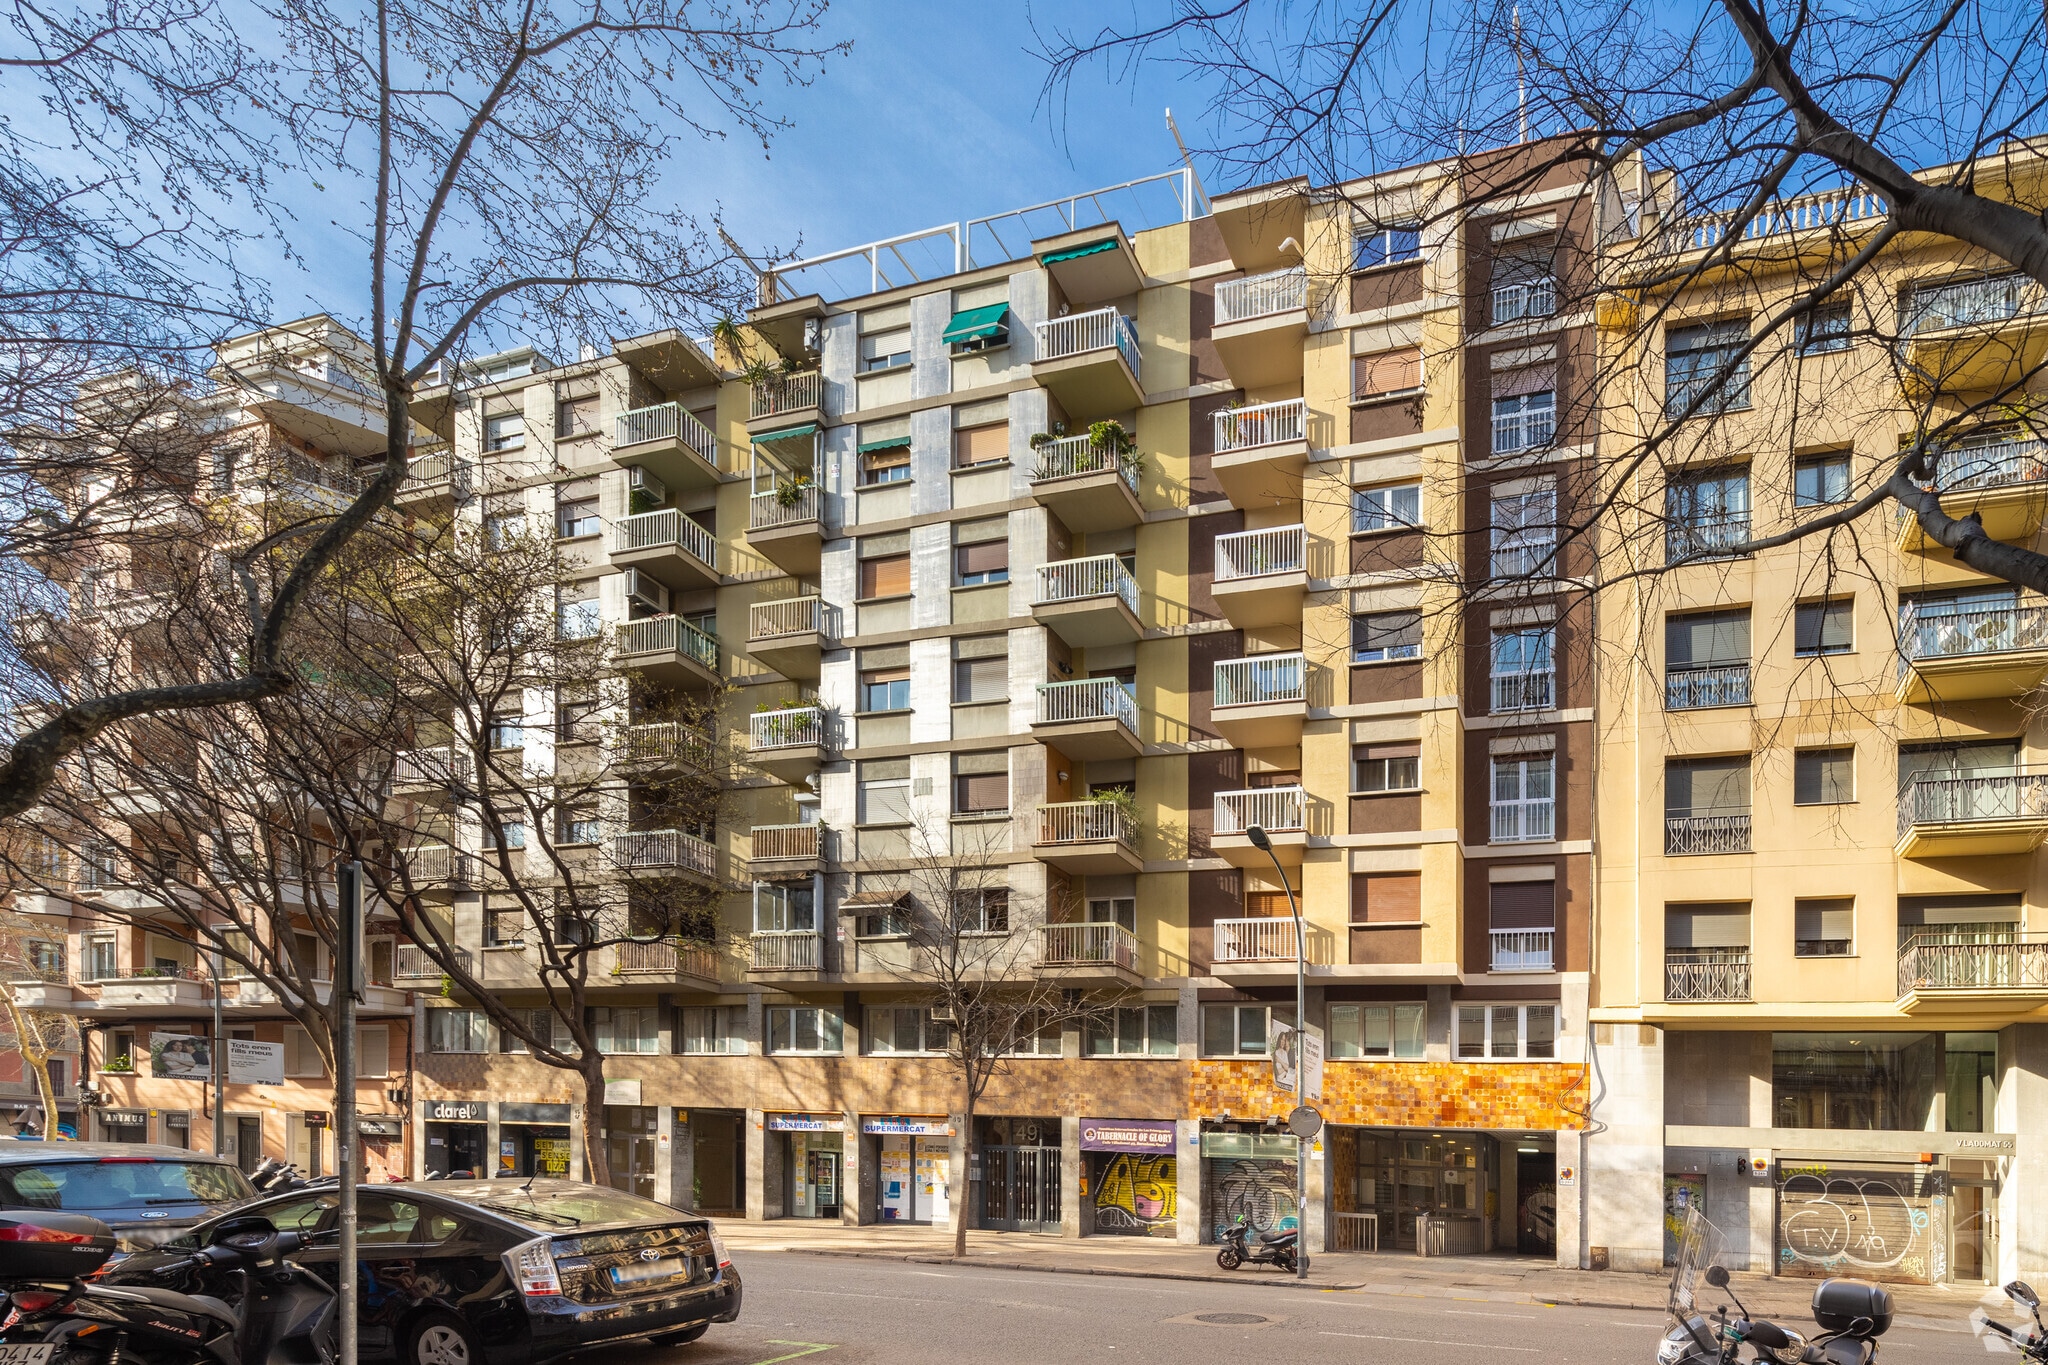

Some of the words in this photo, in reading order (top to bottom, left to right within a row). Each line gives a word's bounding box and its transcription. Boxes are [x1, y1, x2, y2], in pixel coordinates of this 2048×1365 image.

[434, 1103, 471, 1119] clarel
[105, 1113, 144, 1123] ANIMUS
[770, 1121, 822, 1129] SUPERMERCAT
[864, 1125, 926, 1133] SUPERMERCAT
[1015, 1124, 1038, 1141] 49
[1096, 1131, 1137, 1142] TABERNACLE
[1138, 1132, 1148, 1142] OF
[1149, 1133, 1173, 1143] GLORY
[536, 1141, 570, 1149] SETMAN
[541, 1151, 570, 1160] SENSE
[548, 1162, 565, 1170] IVA
[147, 1320, 186, 1334] AGILITY
